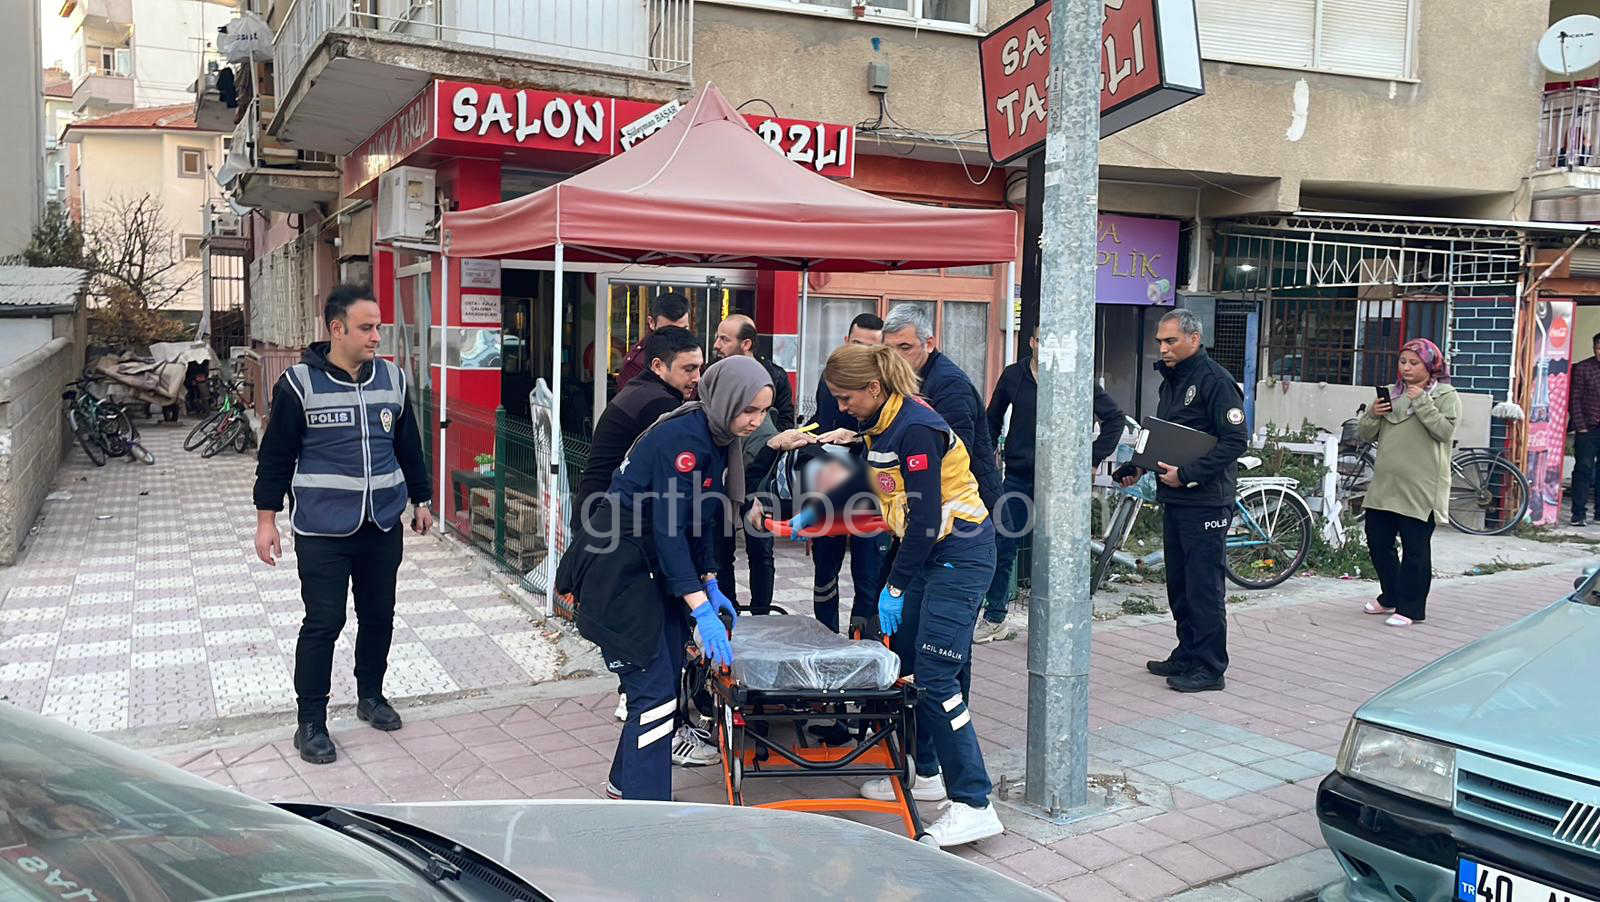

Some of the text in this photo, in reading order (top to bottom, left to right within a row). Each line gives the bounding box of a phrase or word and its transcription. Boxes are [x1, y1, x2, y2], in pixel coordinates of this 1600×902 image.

[997, 18, 1145, 138] TALI
[452, 87, 605, 147] SALON
[1461, 881, 1476, 896] TR
[1477, 869, 1513, 902] 40
